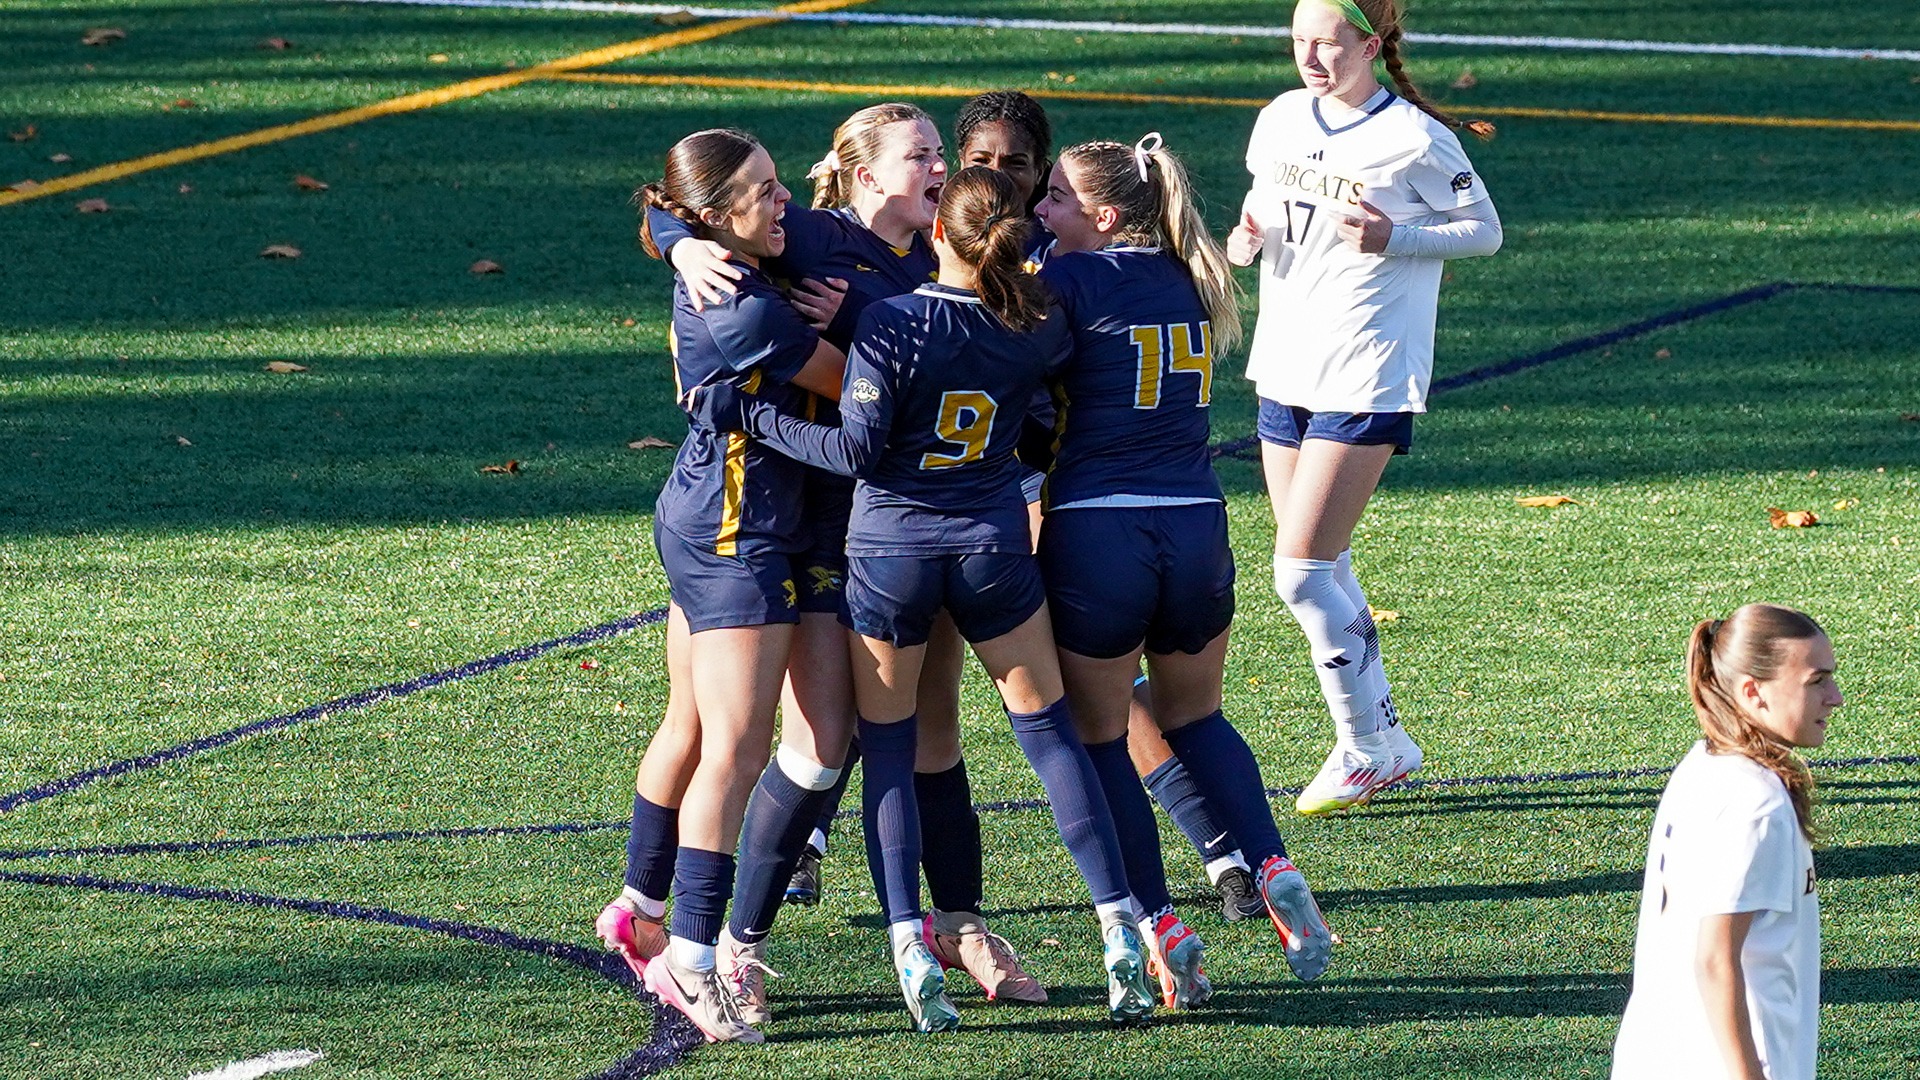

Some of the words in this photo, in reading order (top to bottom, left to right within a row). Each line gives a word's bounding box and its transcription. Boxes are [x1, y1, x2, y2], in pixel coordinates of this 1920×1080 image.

[1273, 161, 1364, 205] OBCATS
[1283, 199, 1317, 246] 17
[1129, 320, 1213, 410] 14
[919, 390, 999, 470] 9
